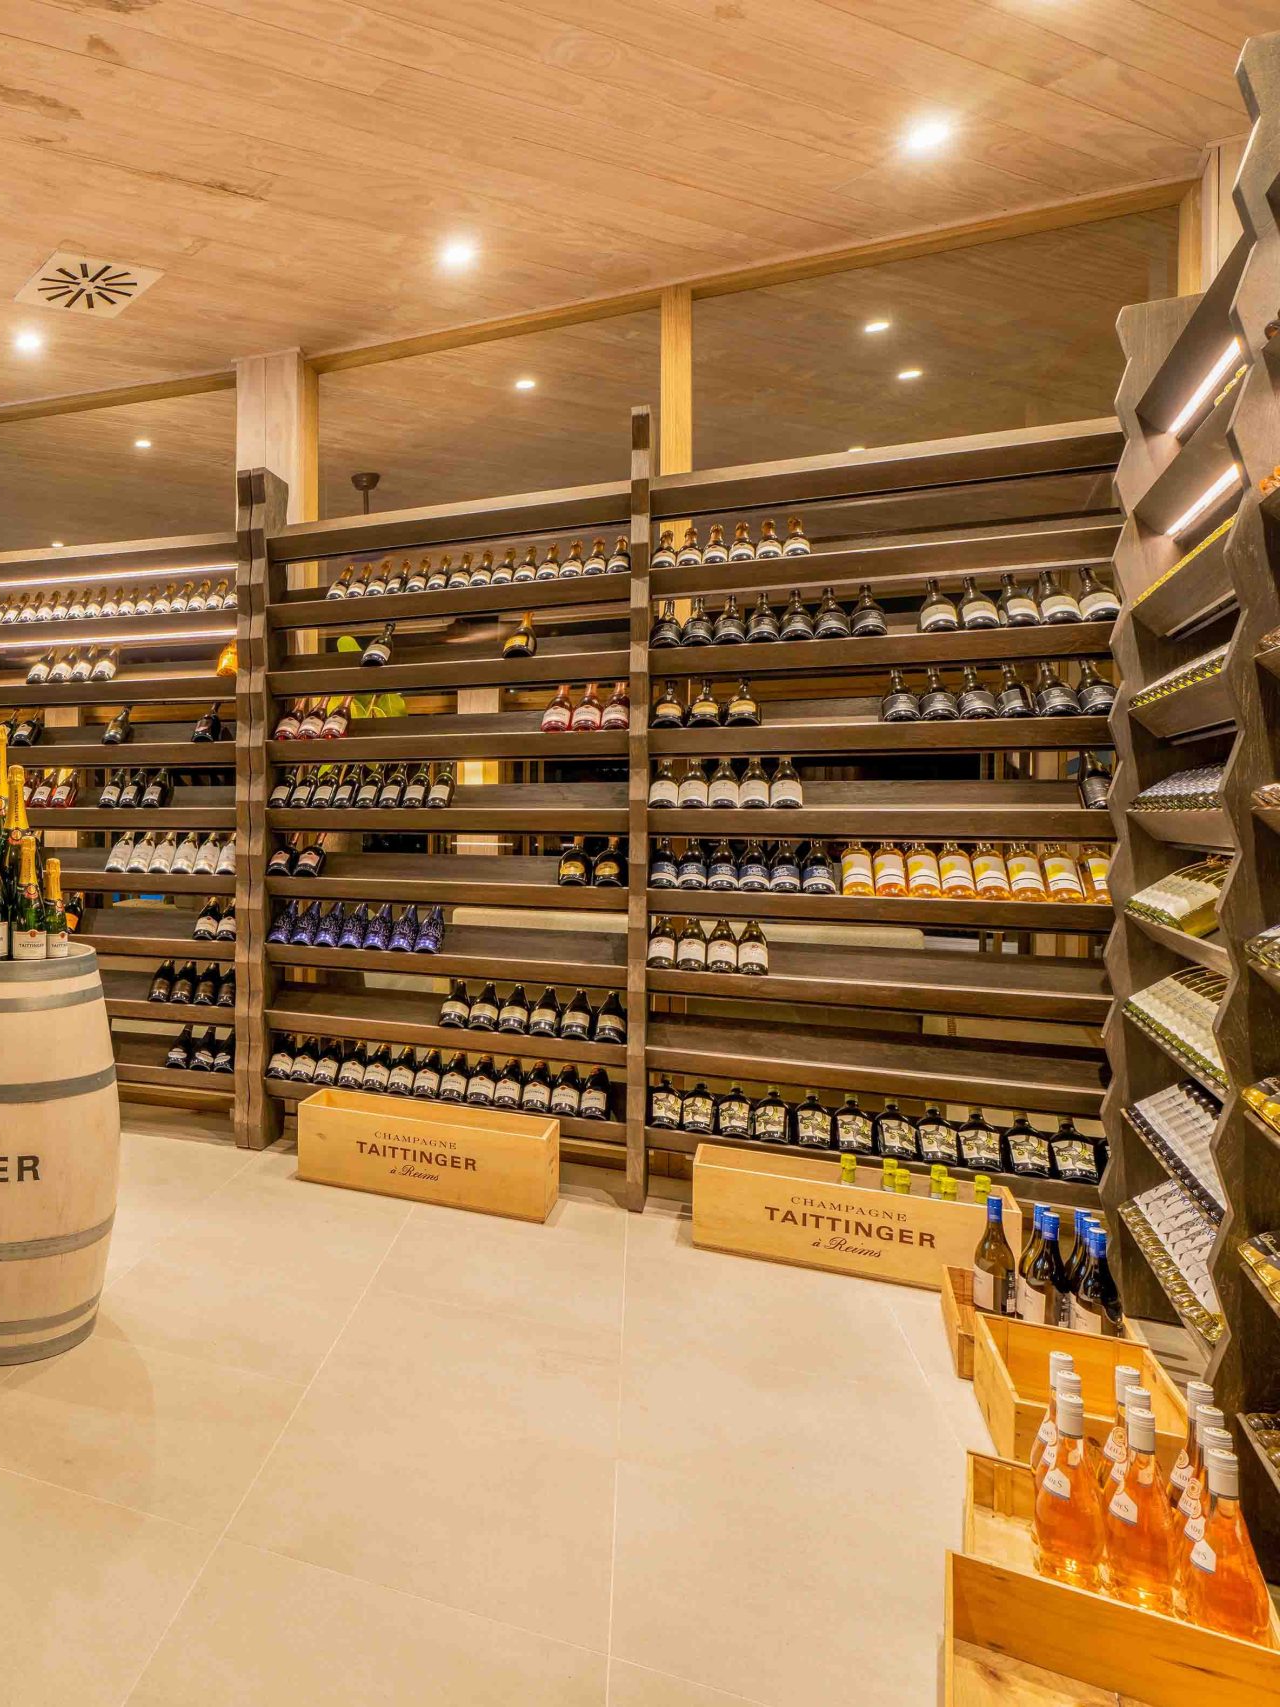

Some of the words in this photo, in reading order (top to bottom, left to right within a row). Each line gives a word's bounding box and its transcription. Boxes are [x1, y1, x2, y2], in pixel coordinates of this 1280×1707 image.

[374, 1130, 457, 1150] CHAMPAGNE
[356, 1140, 477, 1171] TAITTINGER
[389, 1166, 397, 1174] à
[399, 1164, 439, 1182] Reims
[791, 1196, 907, 1222] CHAMPAGNE
[764, 1206, 936, 1249] TAITTINGER
[811, 1238, 822, 1248] à
[824, 1236, 881, 1258] Reims
